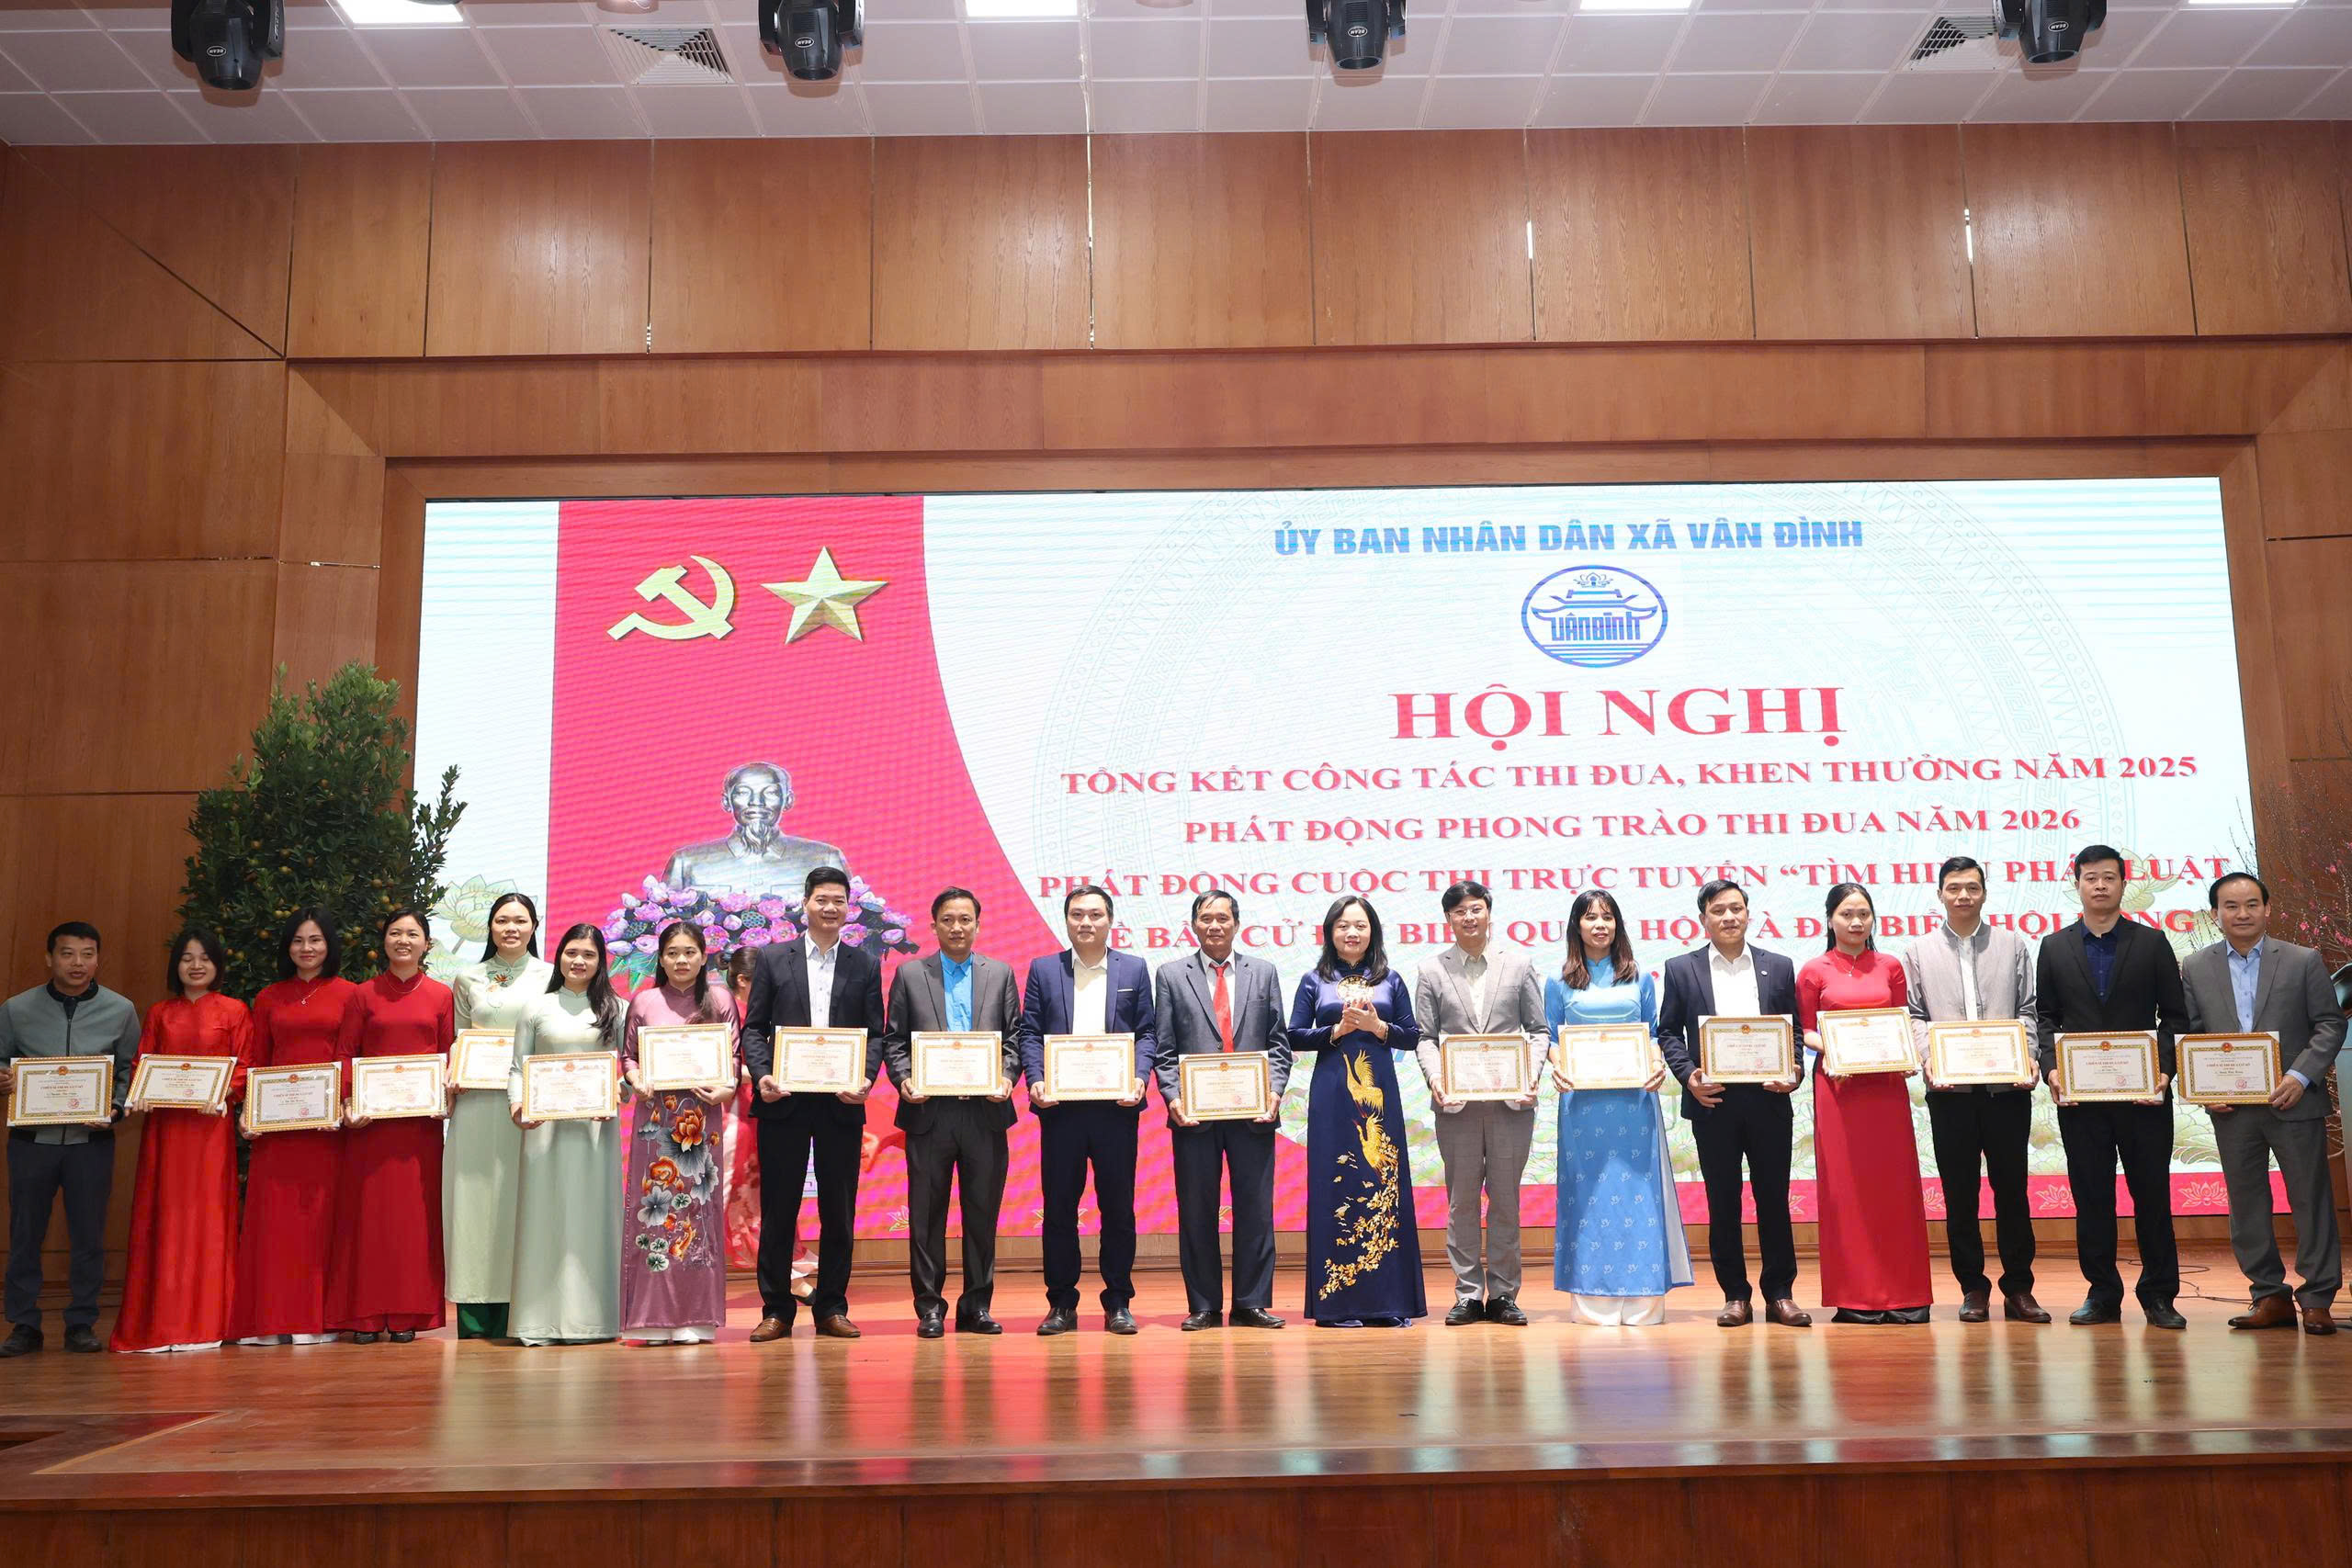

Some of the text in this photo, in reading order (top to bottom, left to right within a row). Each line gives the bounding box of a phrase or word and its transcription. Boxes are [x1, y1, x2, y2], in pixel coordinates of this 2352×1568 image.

[1274, 515, 1863, 556] ỦY BAN NHÂN DÂN XÃ VÂN ĐÌNH
[1387, 683, 1847, 750] HỘI NGHỊ
[1060, 752, 2198, 795] TỔNG KẾT CÔNG TÁC THI ĐUA, KHEN THƯỞNG NĂM 2025
[1183, 806, 2081, 847] PHÁT ĐỘNG PHONG TRÀO THI ĐUA NĂM 2026
[1038, 869, 1148, 897] PHÁT
[1291, 868, 1409, 897] CUỘC
[1503, 863, 1618, 896] TRỰC
[1629, 860, 1769, 889] TUYẾN
[1780, 857, 1879, 886] “TÌM
[2124, 855, 2231, 886] LUẬT
[1240, 918, 1305, 947] CỬ
